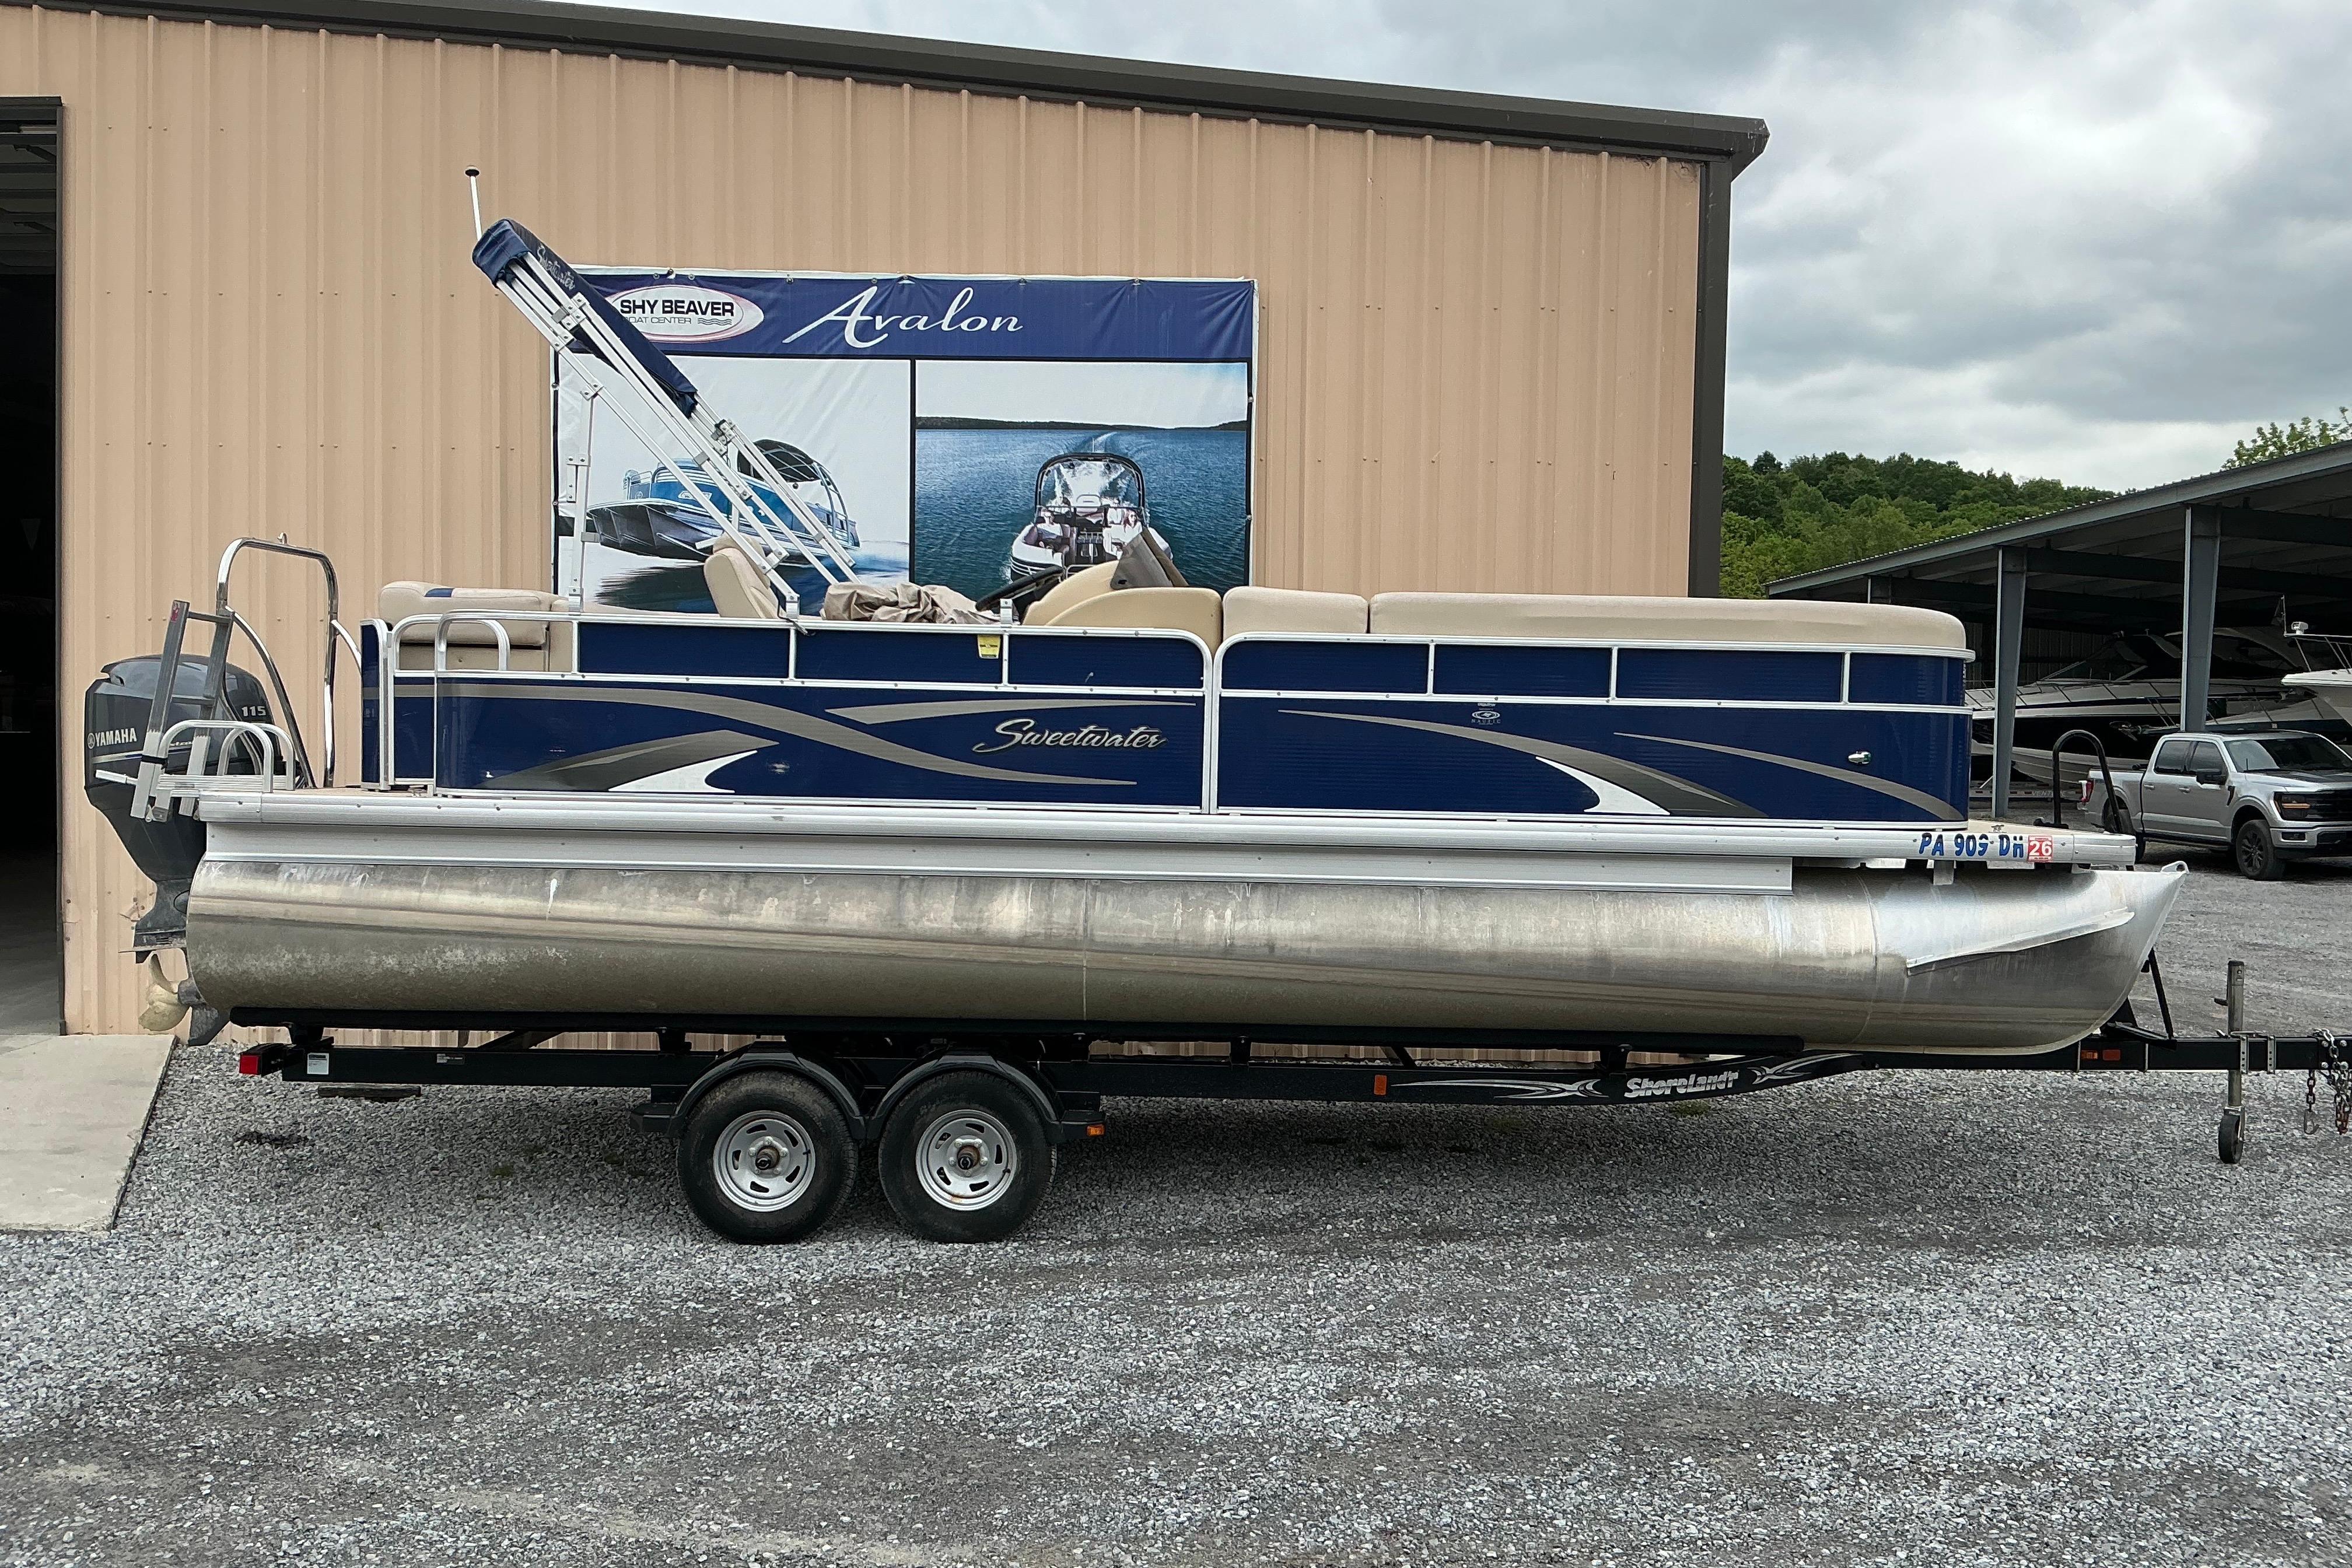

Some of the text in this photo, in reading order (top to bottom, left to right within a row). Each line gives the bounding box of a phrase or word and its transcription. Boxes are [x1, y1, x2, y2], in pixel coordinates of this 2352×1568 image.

[620, 299, 734, 317] SHY BEAVER
[782, 285, 1024, 348] Avalon
[241, 705, 266, 717] 115
[94, 727, 138, 747] YAMAHA
[971, 718, 1167, 753] Sweetwater
[1919, 832, 2024, 858] PA 909 DH
[2029, 840, 2053, 856] 26
